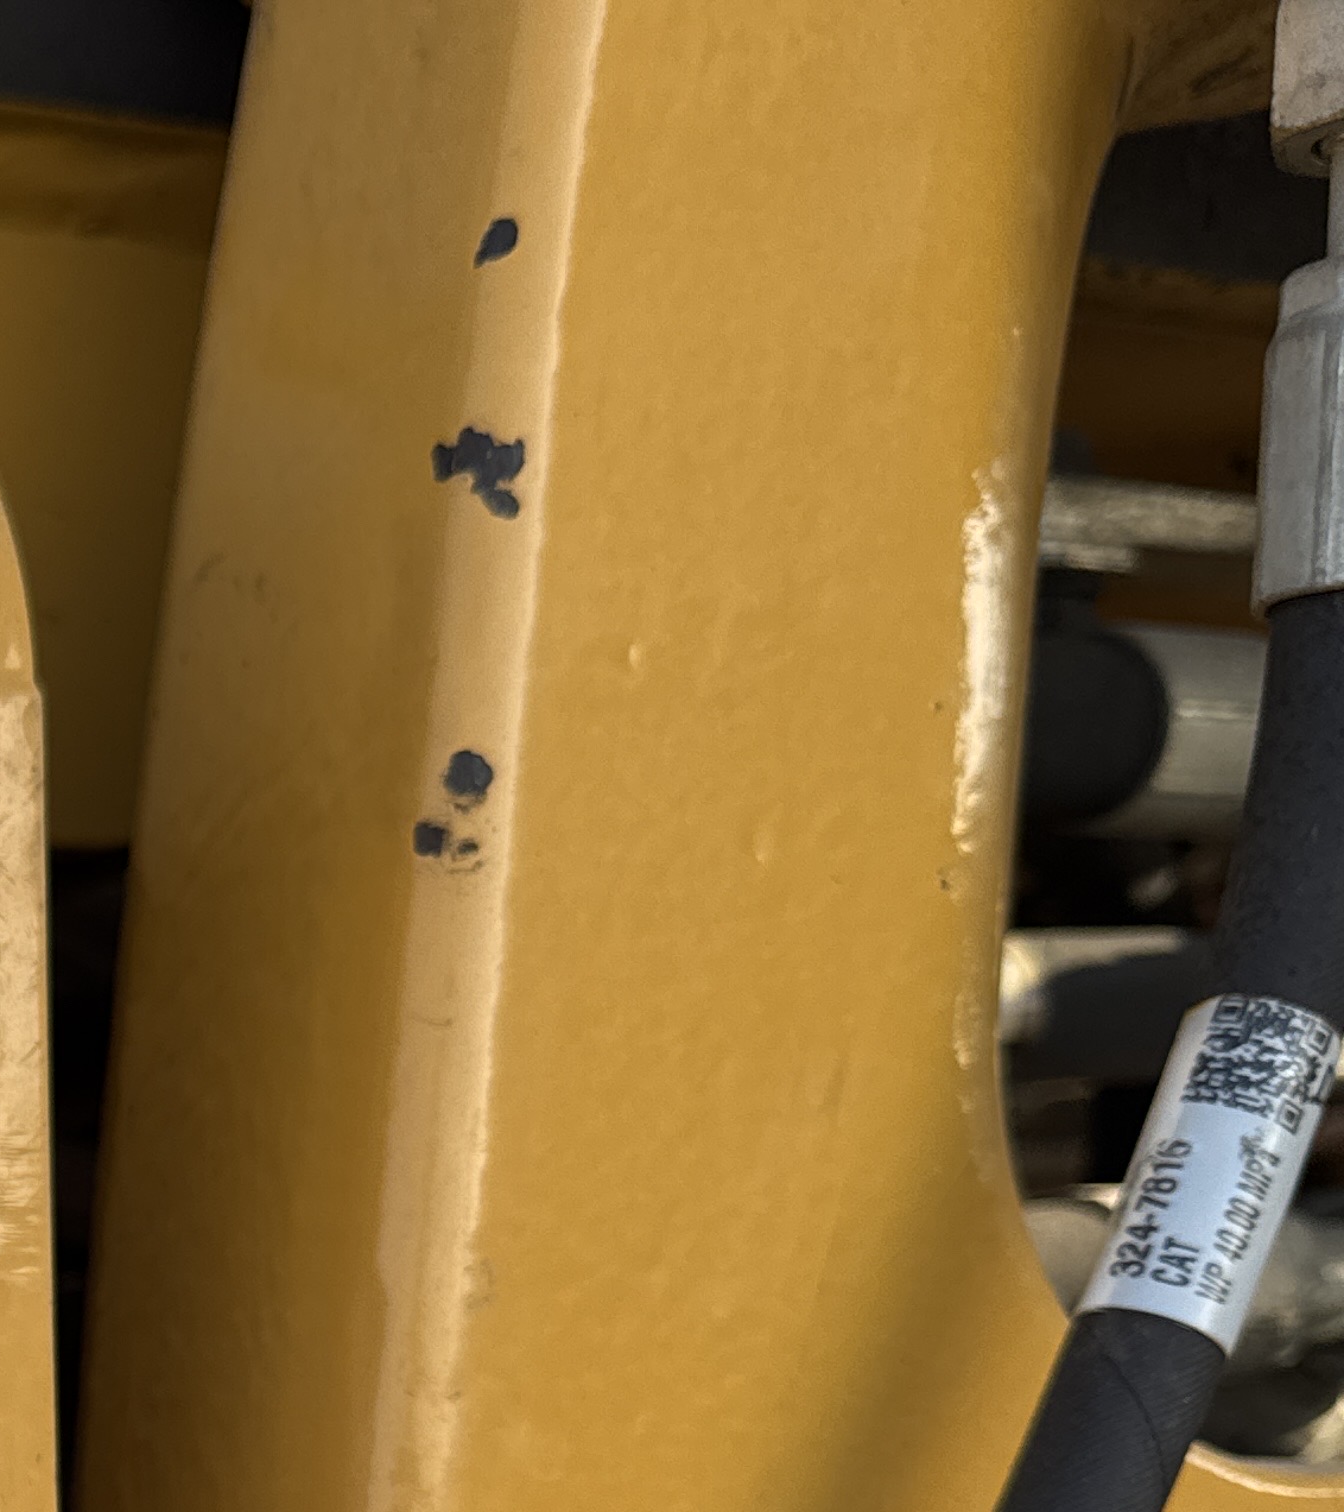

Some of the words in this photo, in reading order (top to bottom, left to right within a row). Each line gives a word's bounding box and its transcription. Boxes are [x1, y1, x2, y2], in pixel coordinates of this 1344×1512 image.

[1109, 1137, 1193, 1280] 324-7816
[1212, 1196, 1261, 1261] 40.00
[1150, 1236, 1200, 1288] CAT
[1194, 1261, 1233, 1305] WP
